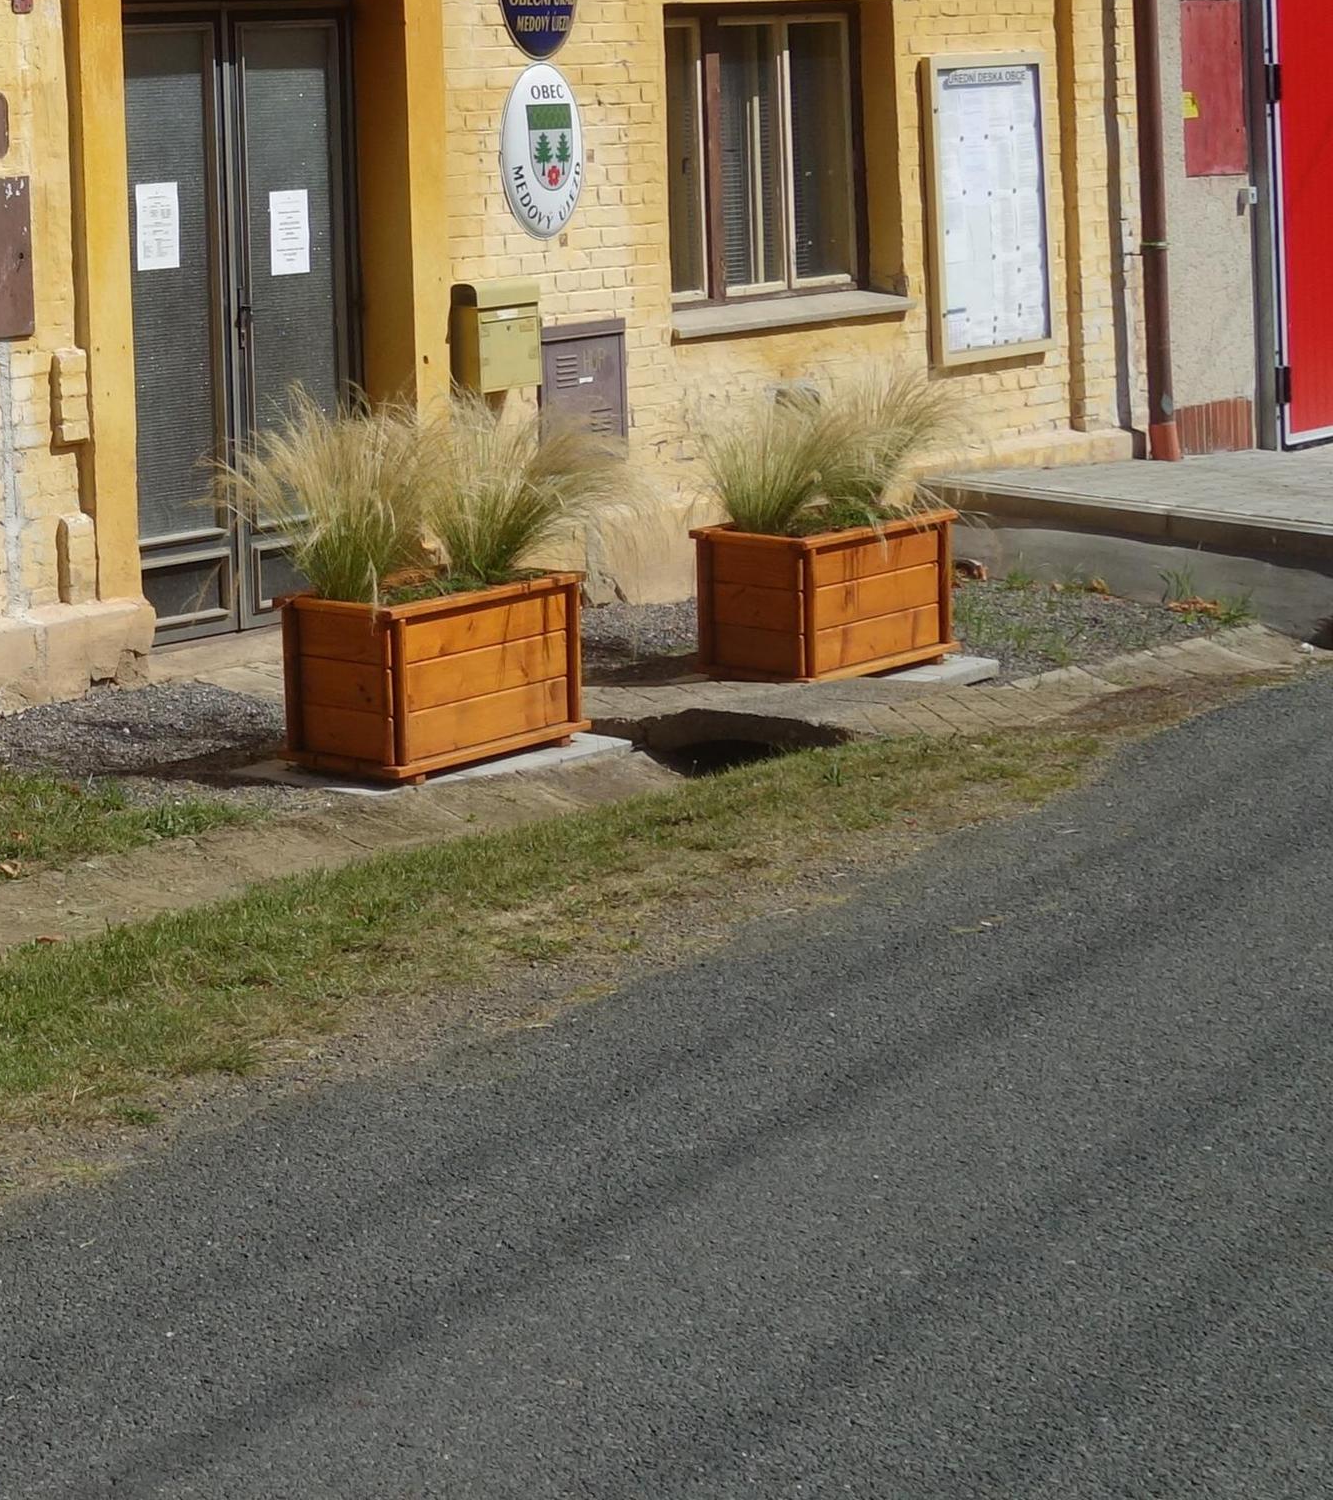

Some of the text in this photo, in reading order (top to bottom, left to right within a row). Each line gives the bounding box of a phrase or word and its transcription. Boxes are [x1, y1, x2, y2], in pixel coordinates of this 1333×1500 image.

[516, 11, 550, 32] MEDOVÝ
[978, 71, 1004, 83] DESKA
[530, 84, 565, 100] OBEC
[512, 165, 554, 230] MEDOVÝ
